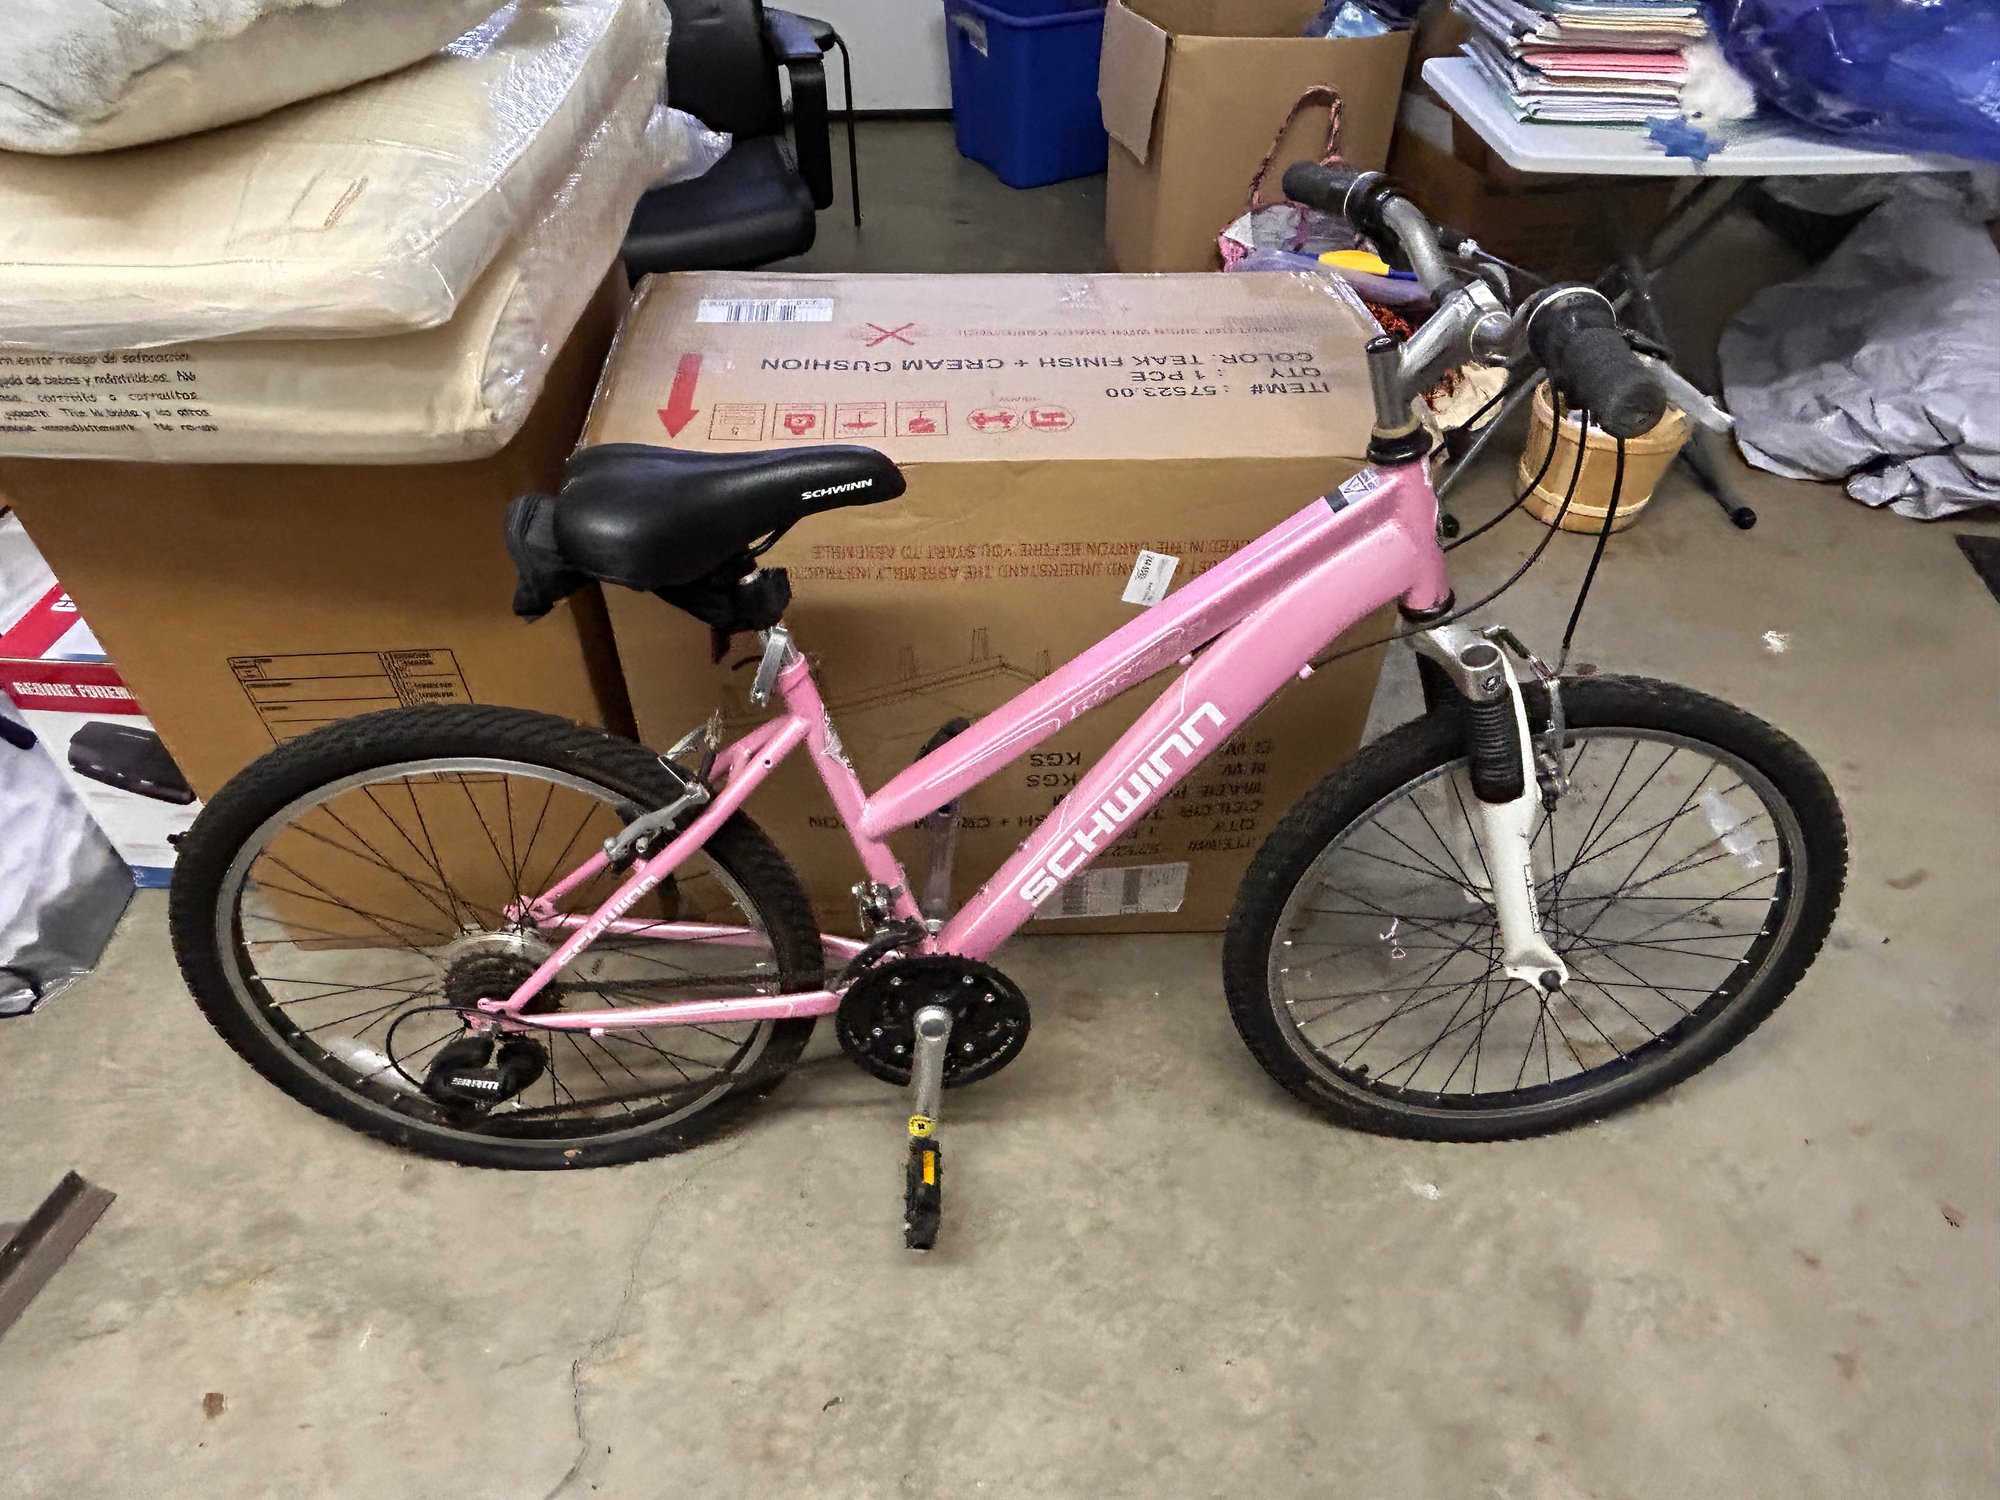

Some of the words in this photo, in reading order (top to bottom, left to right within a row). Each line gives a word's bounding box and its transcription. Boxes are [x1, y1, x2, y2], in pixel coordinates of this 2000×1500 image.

[760, 357, 892, 373] CUSHION
[902, 358, 1004, 372] CREAM
[1039, 356, 1124, 368] FINISH
[1132, 353, 1205, 366] TEAK
[1129, 370, 1184, 382] PCE
[1269, 366, 1322, 379] QTY
[1104, 385, 1218, 399] 57523.00
[1249, 381, 1331, 396] ITEM#
[801, 478, 873, 500] SCHWINN
[1029, 751, 1082, 767] KGS
[1026, 773, 1077, 788] KGS
[1019, 701, 1228, 908] SCHWINN
